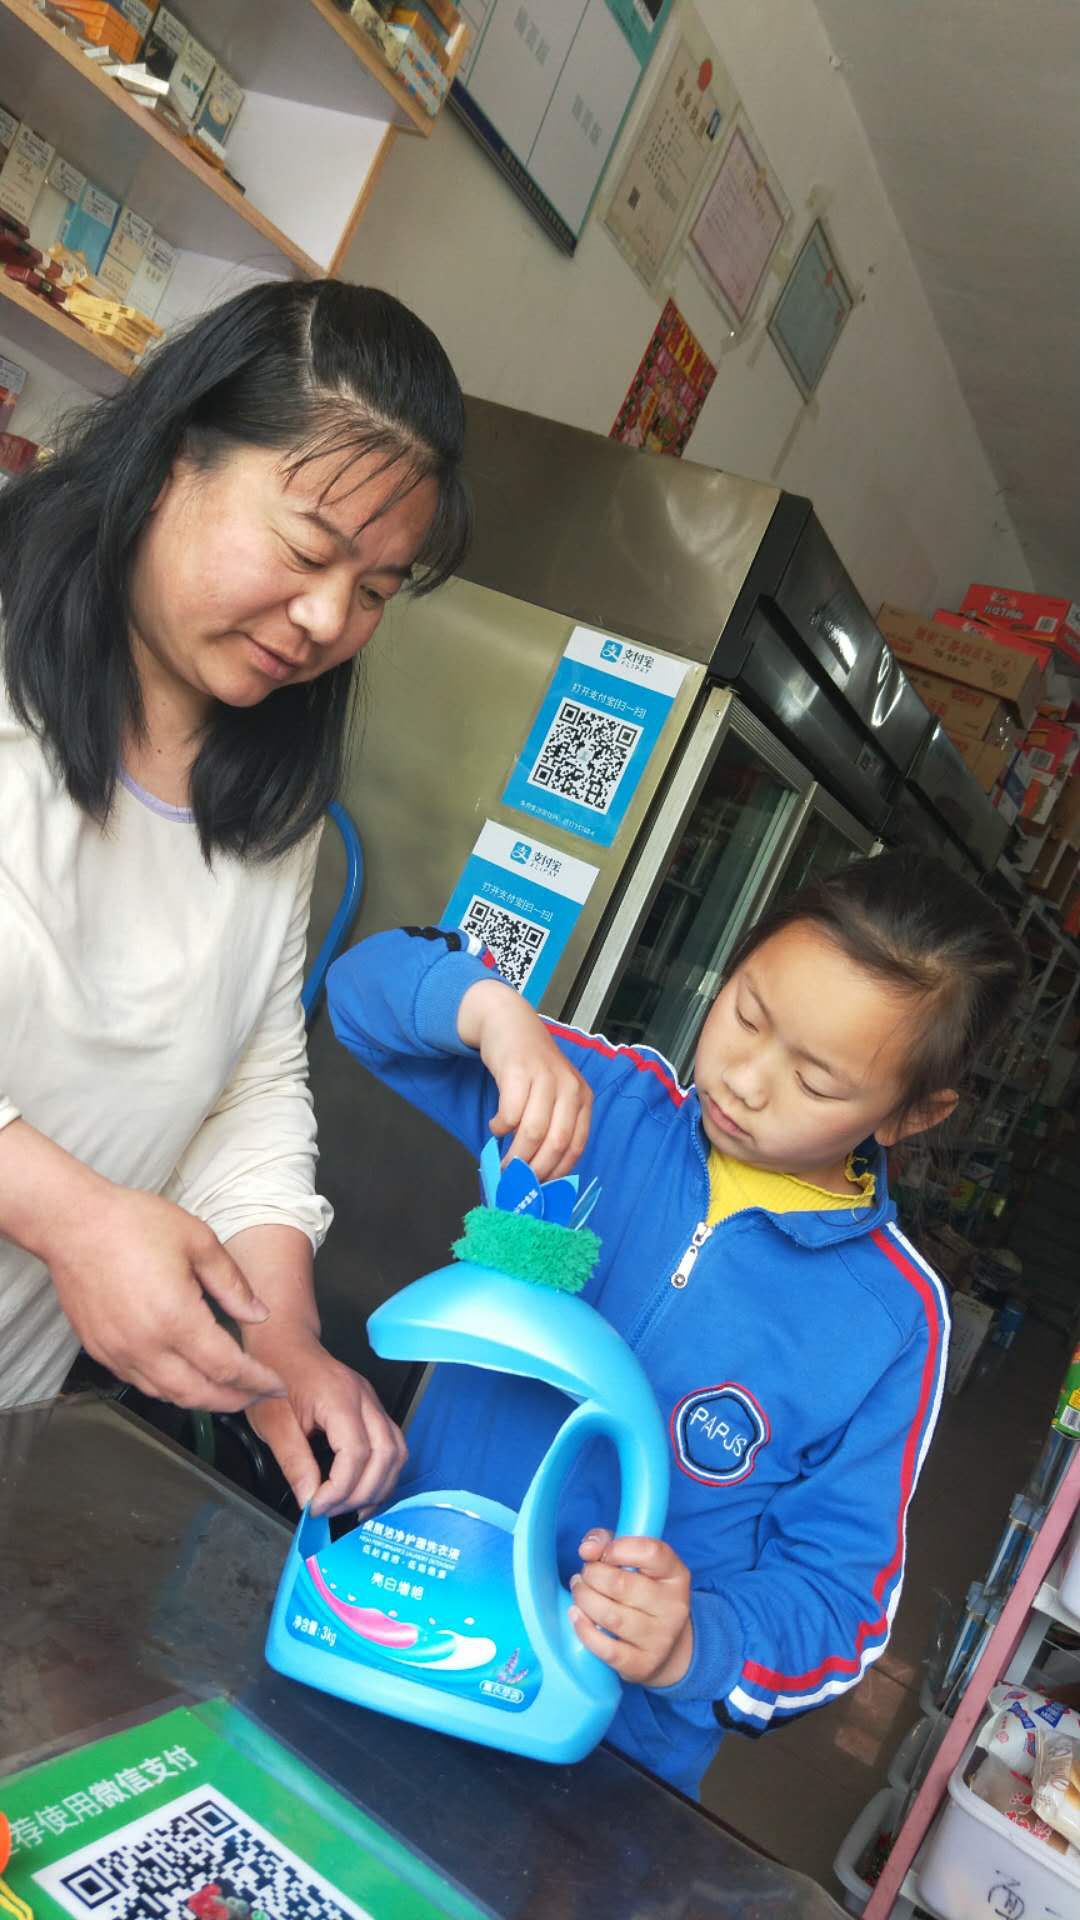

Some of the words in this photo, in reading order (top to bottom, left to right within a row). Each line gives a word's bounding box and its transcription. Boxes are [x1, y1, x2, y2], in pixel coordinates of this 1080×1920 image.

[623, 648, 655, 668] 支付宝
[534, 851, 562, 873] 支付宝
[10, 1744, 199, 1856] 荐使用微信支付
